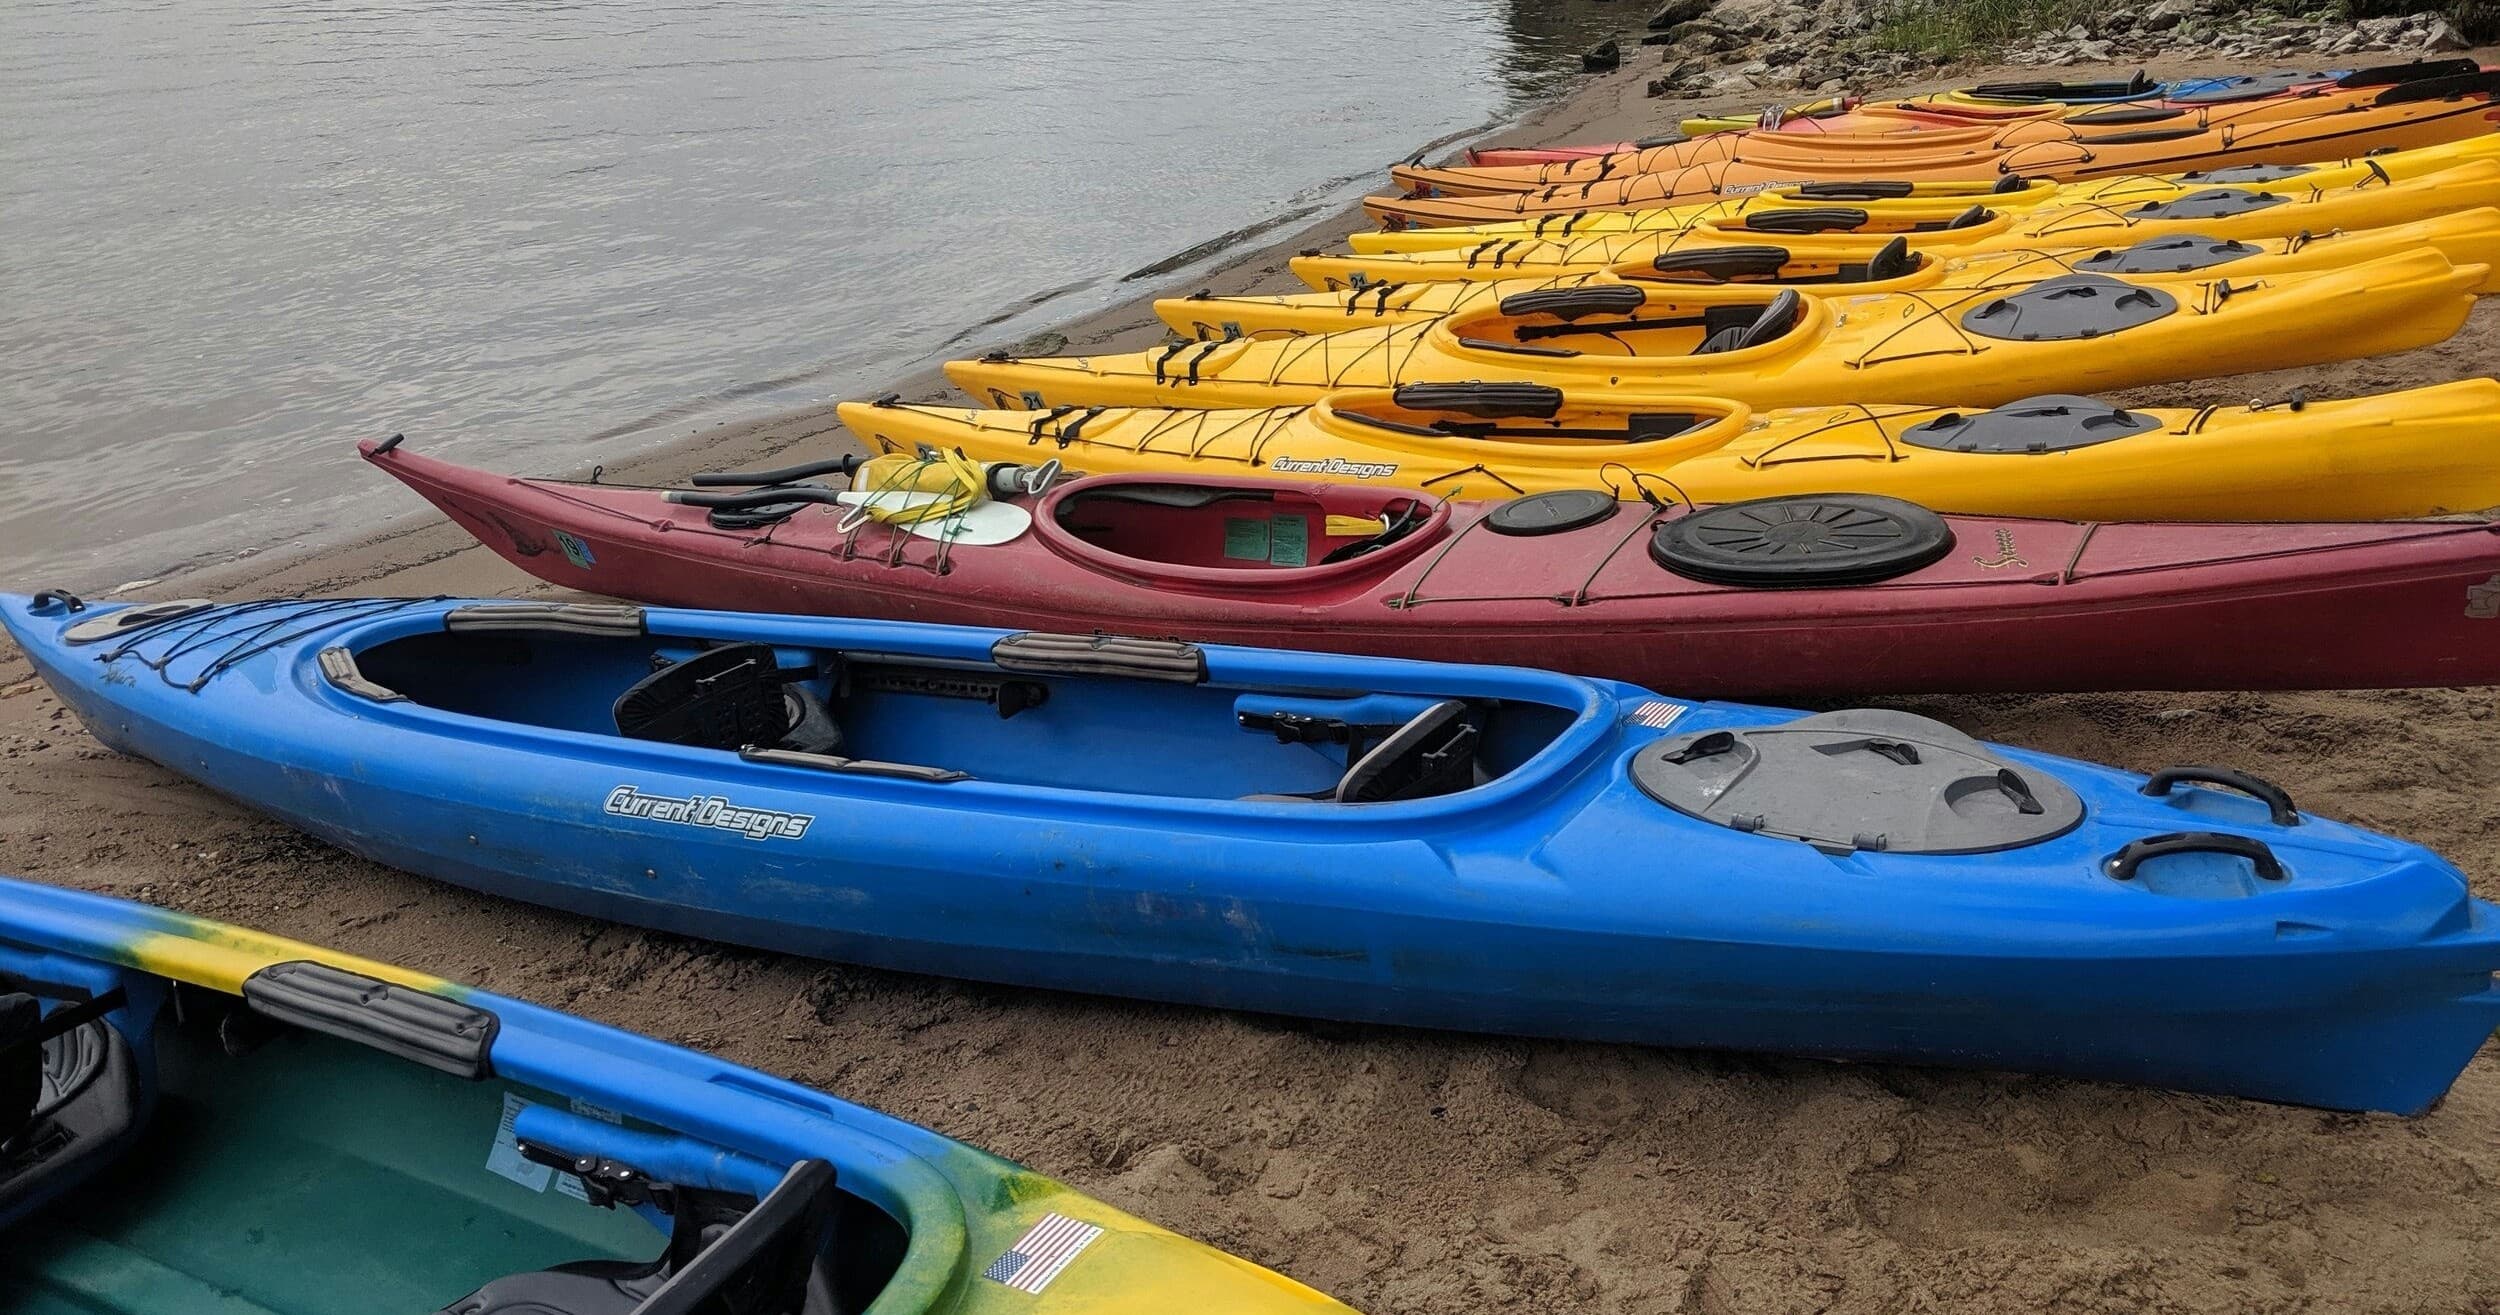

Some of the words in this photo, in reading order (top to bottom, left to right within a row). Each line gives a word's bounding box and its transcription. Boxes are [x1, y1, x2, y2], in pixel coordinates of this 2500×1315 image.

[1024, 396, 1044, 410] 21
[1271, 456, 1328, 473] Current
[1326, 458, 1399, 478] Designs
[559, 535, 580, 556] 19
[604, 785, 701, 824] Current
[696, 795, 815, 840] Designs
